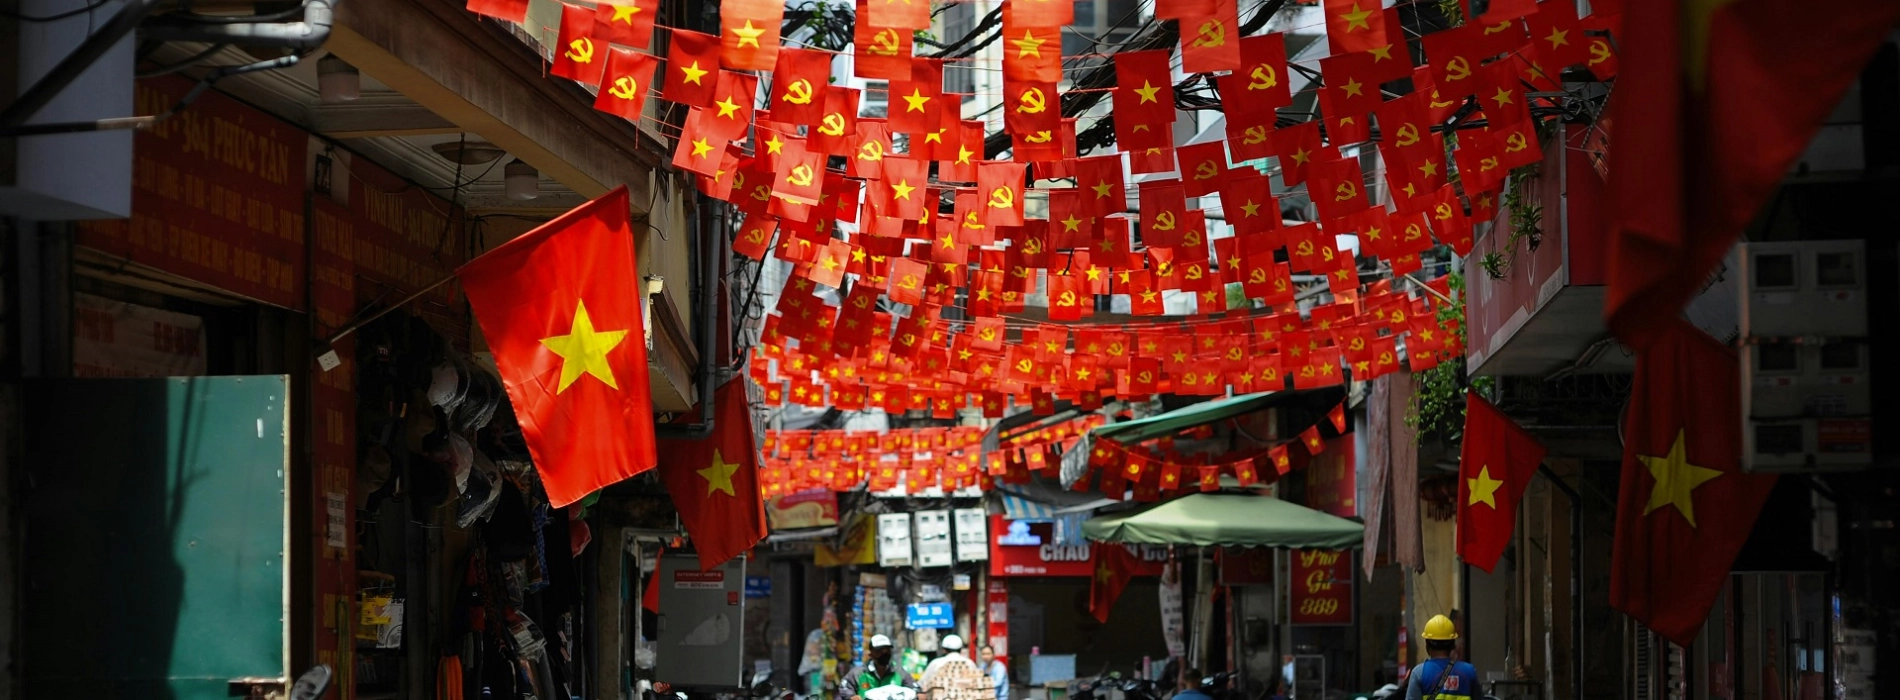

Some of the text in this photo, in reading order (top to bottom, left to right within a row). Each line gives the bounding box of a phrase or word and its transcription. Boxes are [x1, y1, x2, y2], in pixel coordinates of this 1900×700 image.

[182, 110, 211, 160] 364
[213, 114, 256, 173] PHÚC
[258, 128, 289, 185] TÂN
